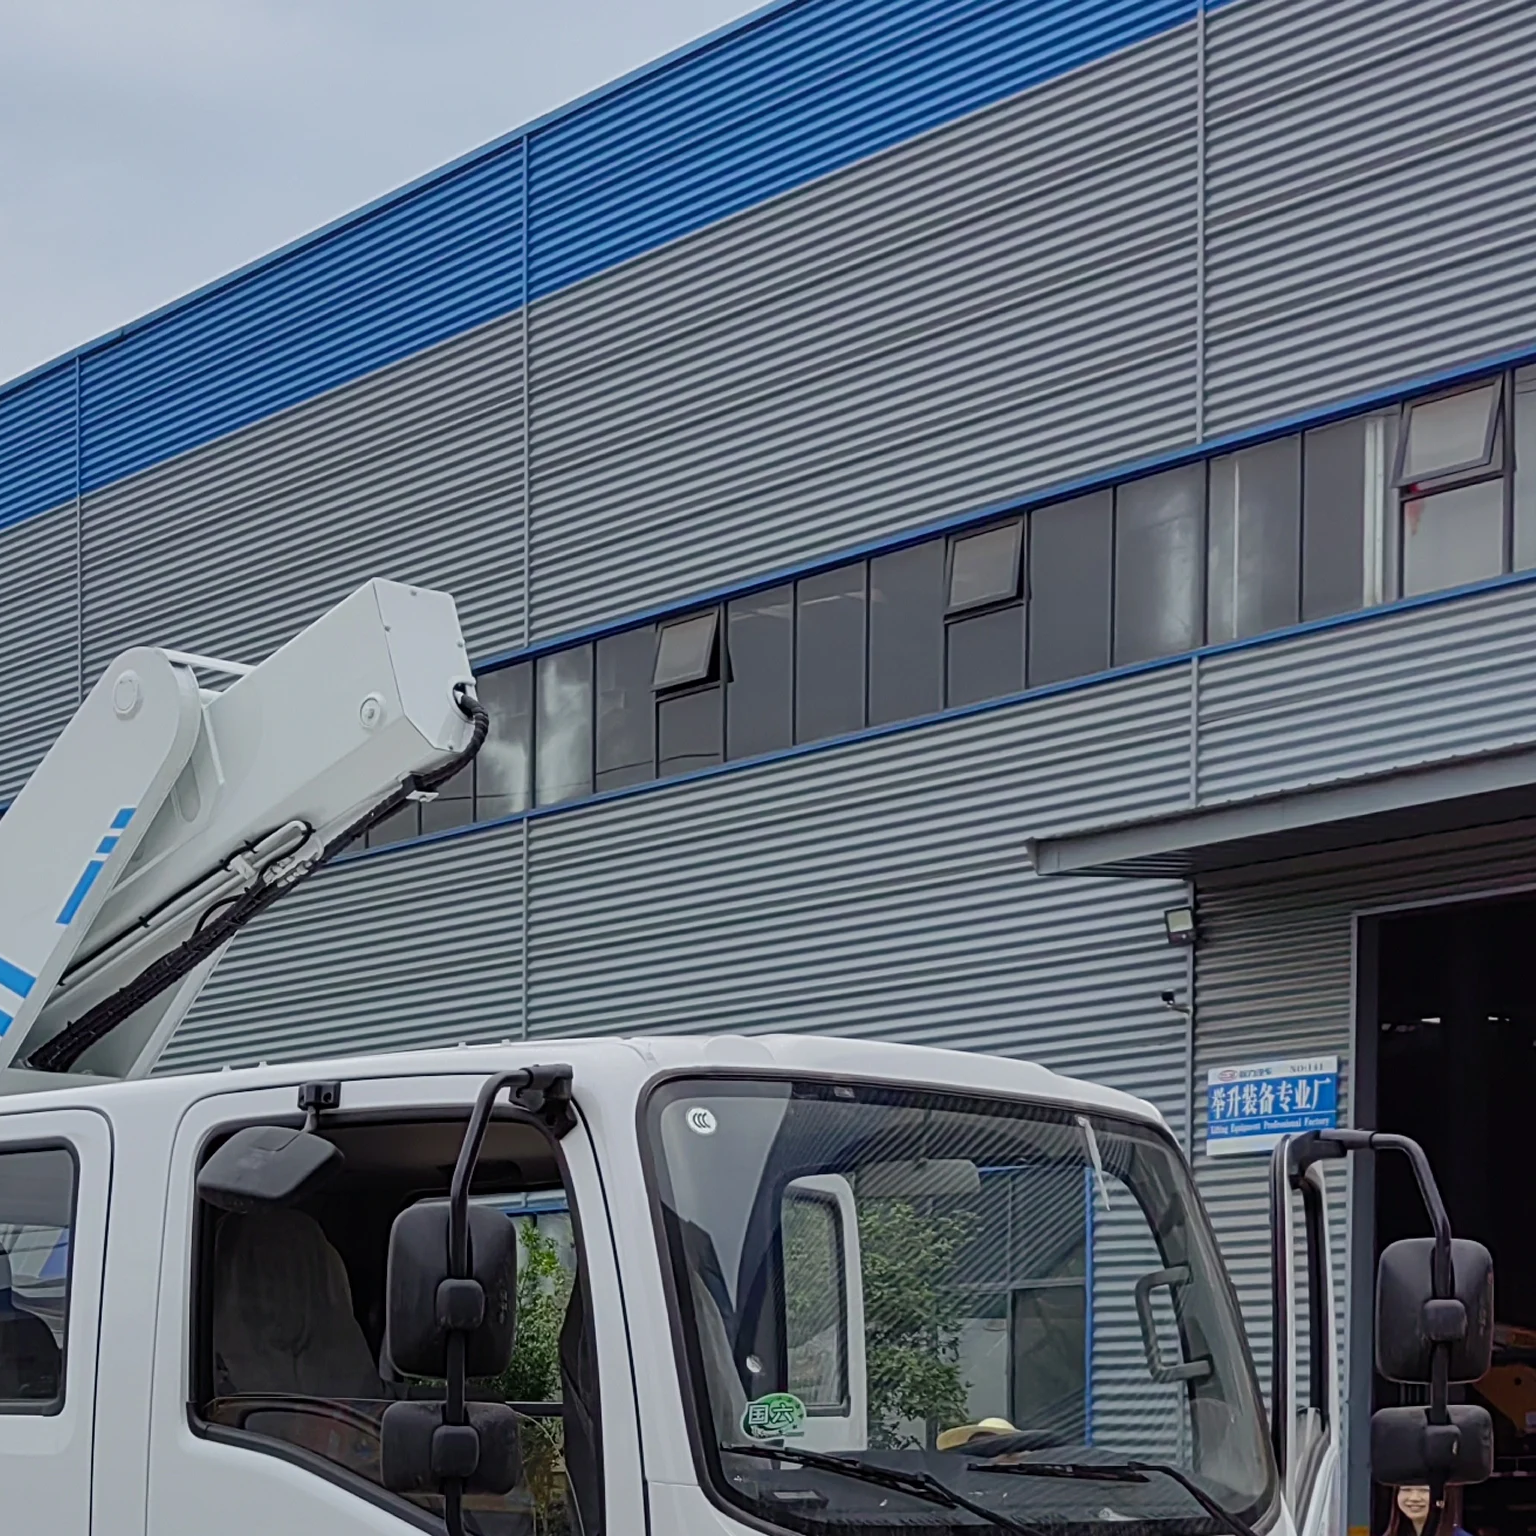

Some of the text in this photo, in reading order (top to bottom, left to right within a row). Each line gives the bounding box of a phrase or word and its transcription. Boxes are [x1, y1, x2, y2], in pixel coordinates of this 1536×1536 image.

[1212, 1077, 1331, 1119] 举升装备专业厂
[1231, 1122, 1261, 1133] Equipment
[1264, 1118, 1301, 1129] Professional
[1305, 1117, 1330, 1127] Factory
[748, 1403, 794, 1425] 国六
